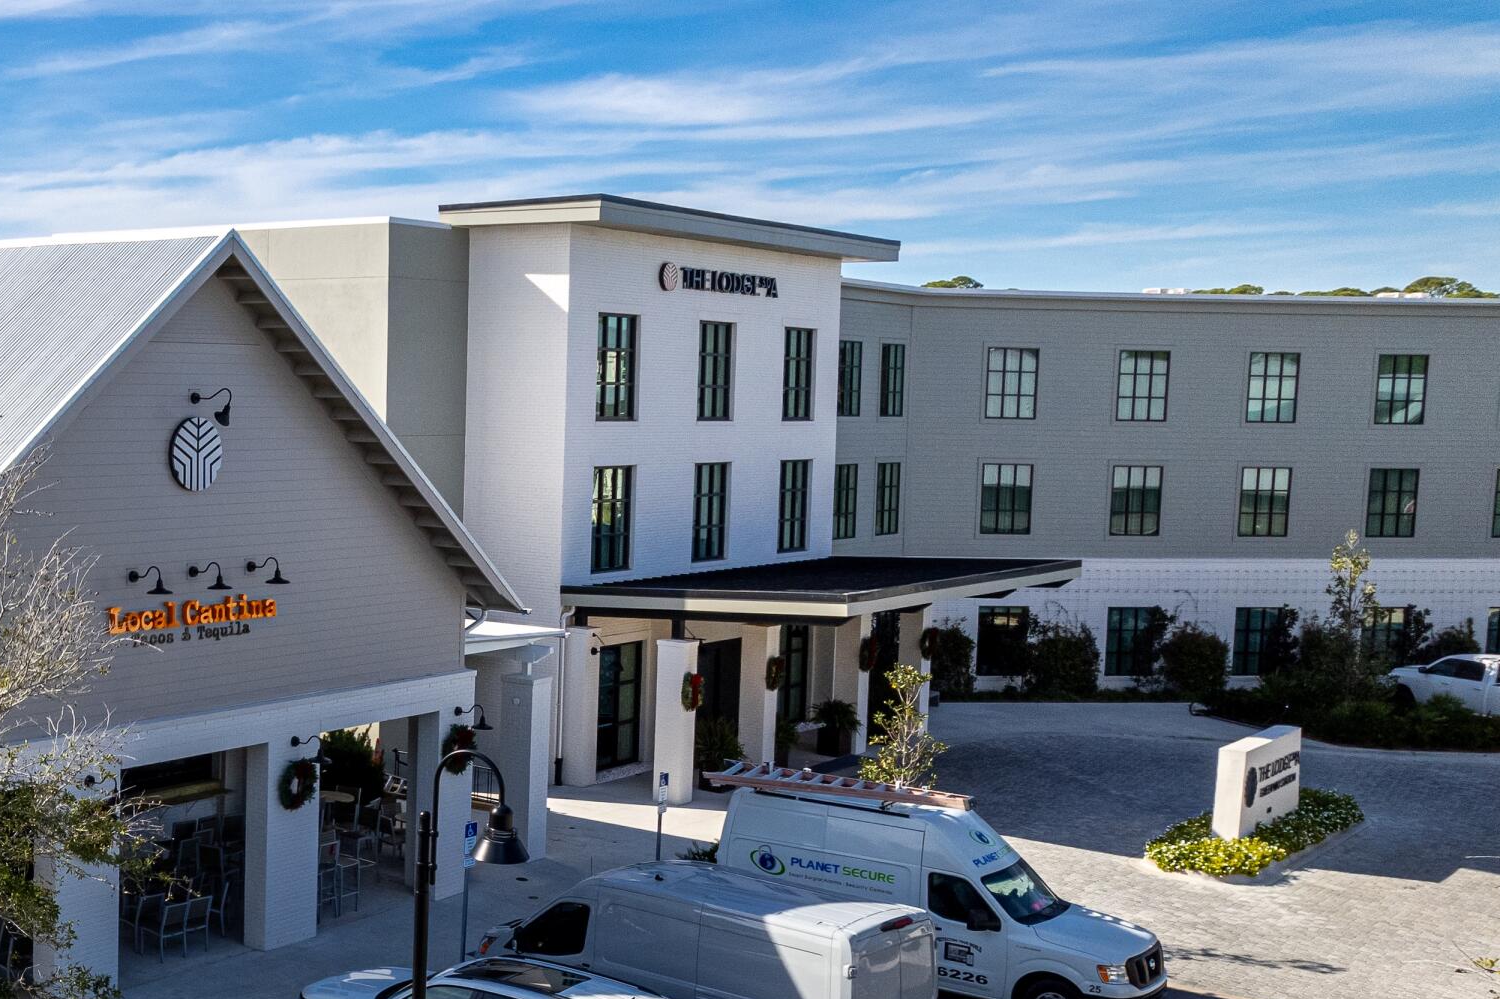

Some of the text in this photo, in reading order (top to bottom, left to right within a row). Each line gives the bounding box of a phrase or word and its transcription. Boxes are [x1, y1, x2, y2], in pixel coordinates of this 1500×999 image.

[680, 267, 711, 291] THE
[711, 271, 760, 296] LODGE
[106, 593, 277, 636] Local Cantina
[131, 631, 175, 648] Tacos
[197, 621, 251, 641] Tequila
[790, 856, 896, 885] PLANET SECURE
[937, 966, 989, 985] 6226
[1089, 984, 1102, 994] 25
